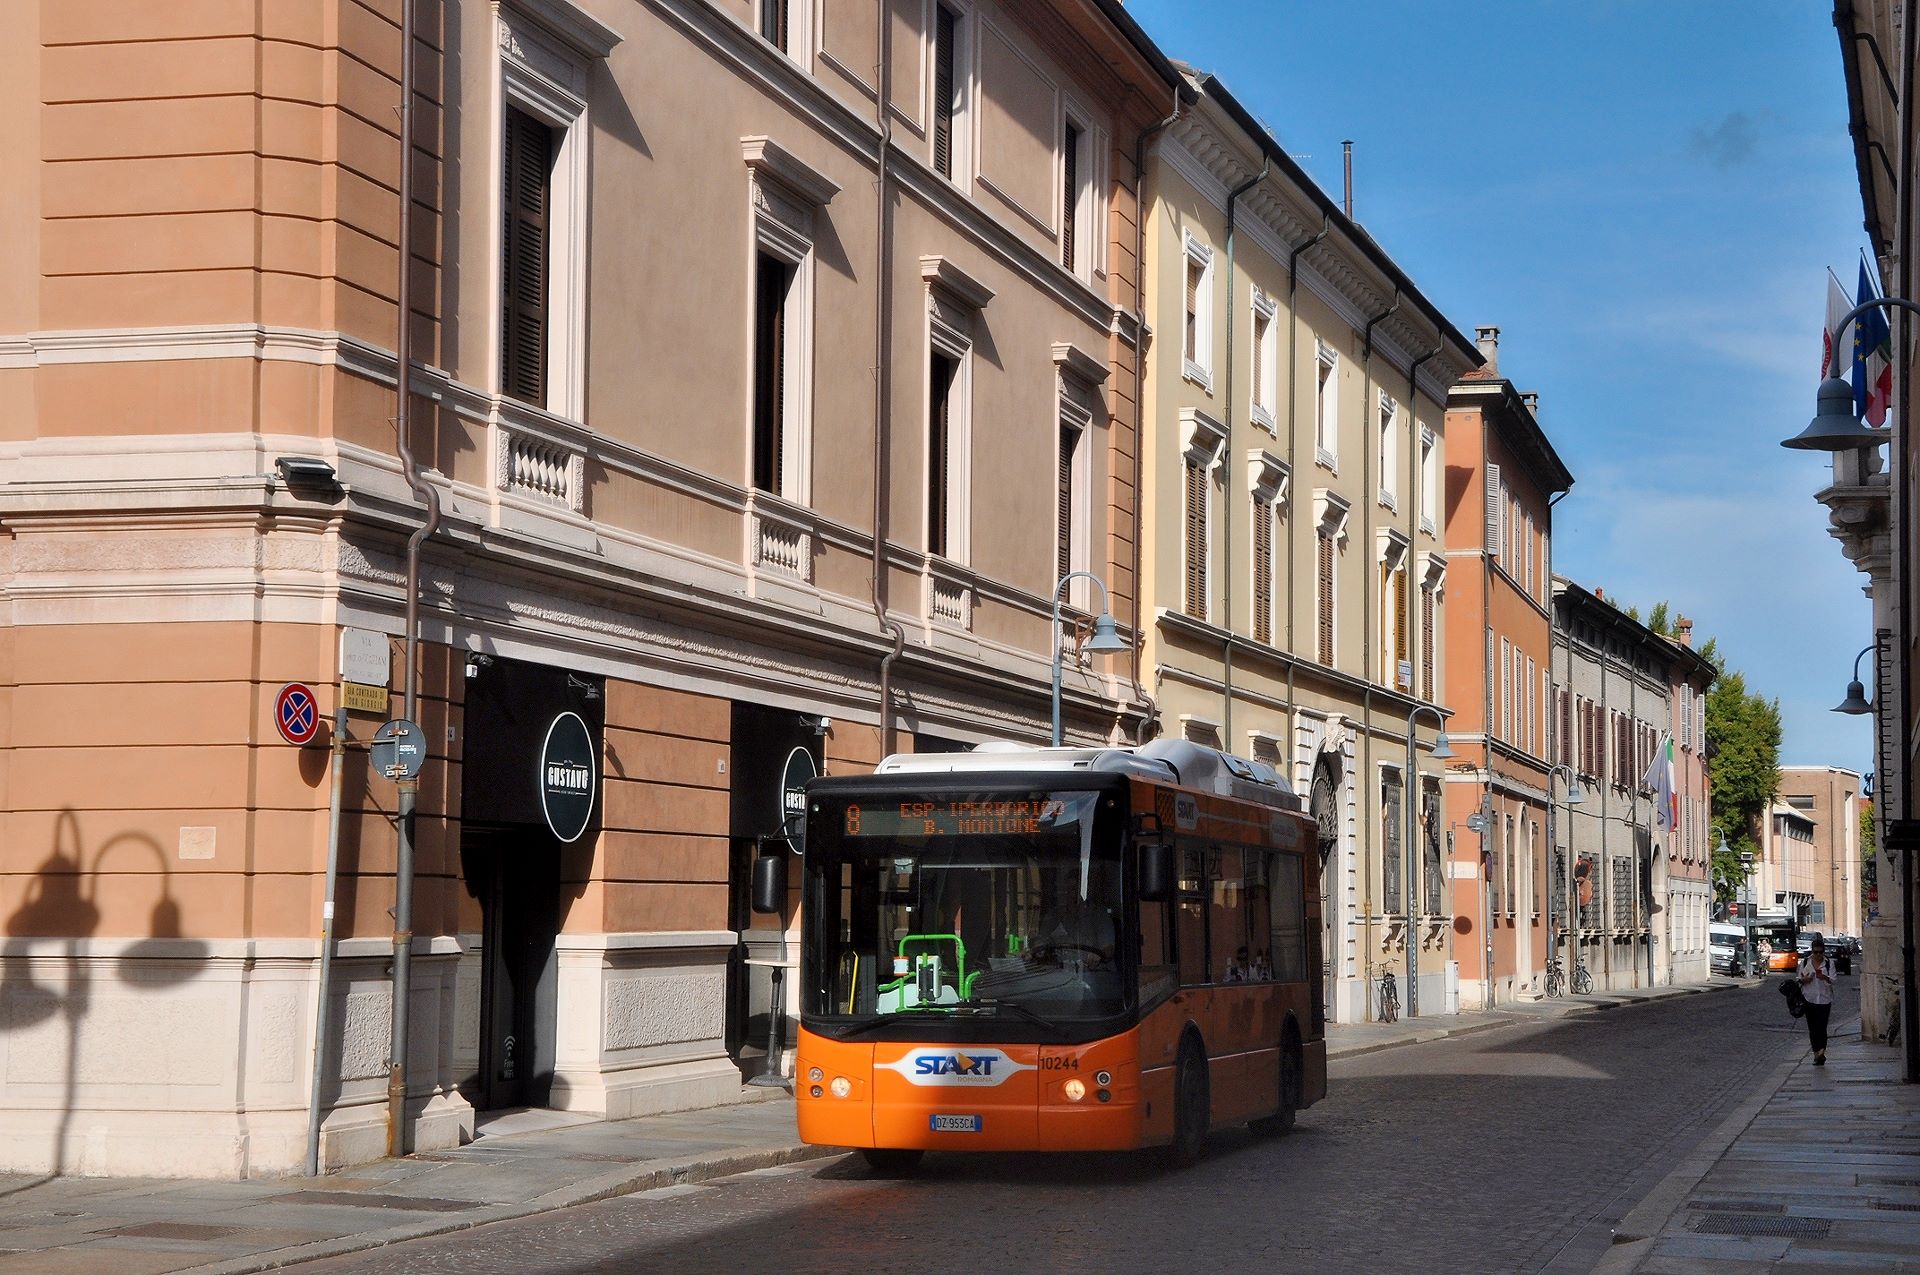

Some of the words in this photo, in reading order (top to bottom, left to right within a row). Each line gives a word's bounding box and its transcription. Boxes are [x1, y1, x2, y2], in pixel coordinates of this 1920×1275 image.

[548, 766, 588, 789] GUSTAVO
[786, 792, 806, 810] GUSTA
[847, 803, 860, 834] 8
[923, 819, 945, 834] B.
[958, 818, 1041, 834] MONTONE
[914, 1056, 999, 1076] START
[1040, 1056, 1080, 1071] 10244
